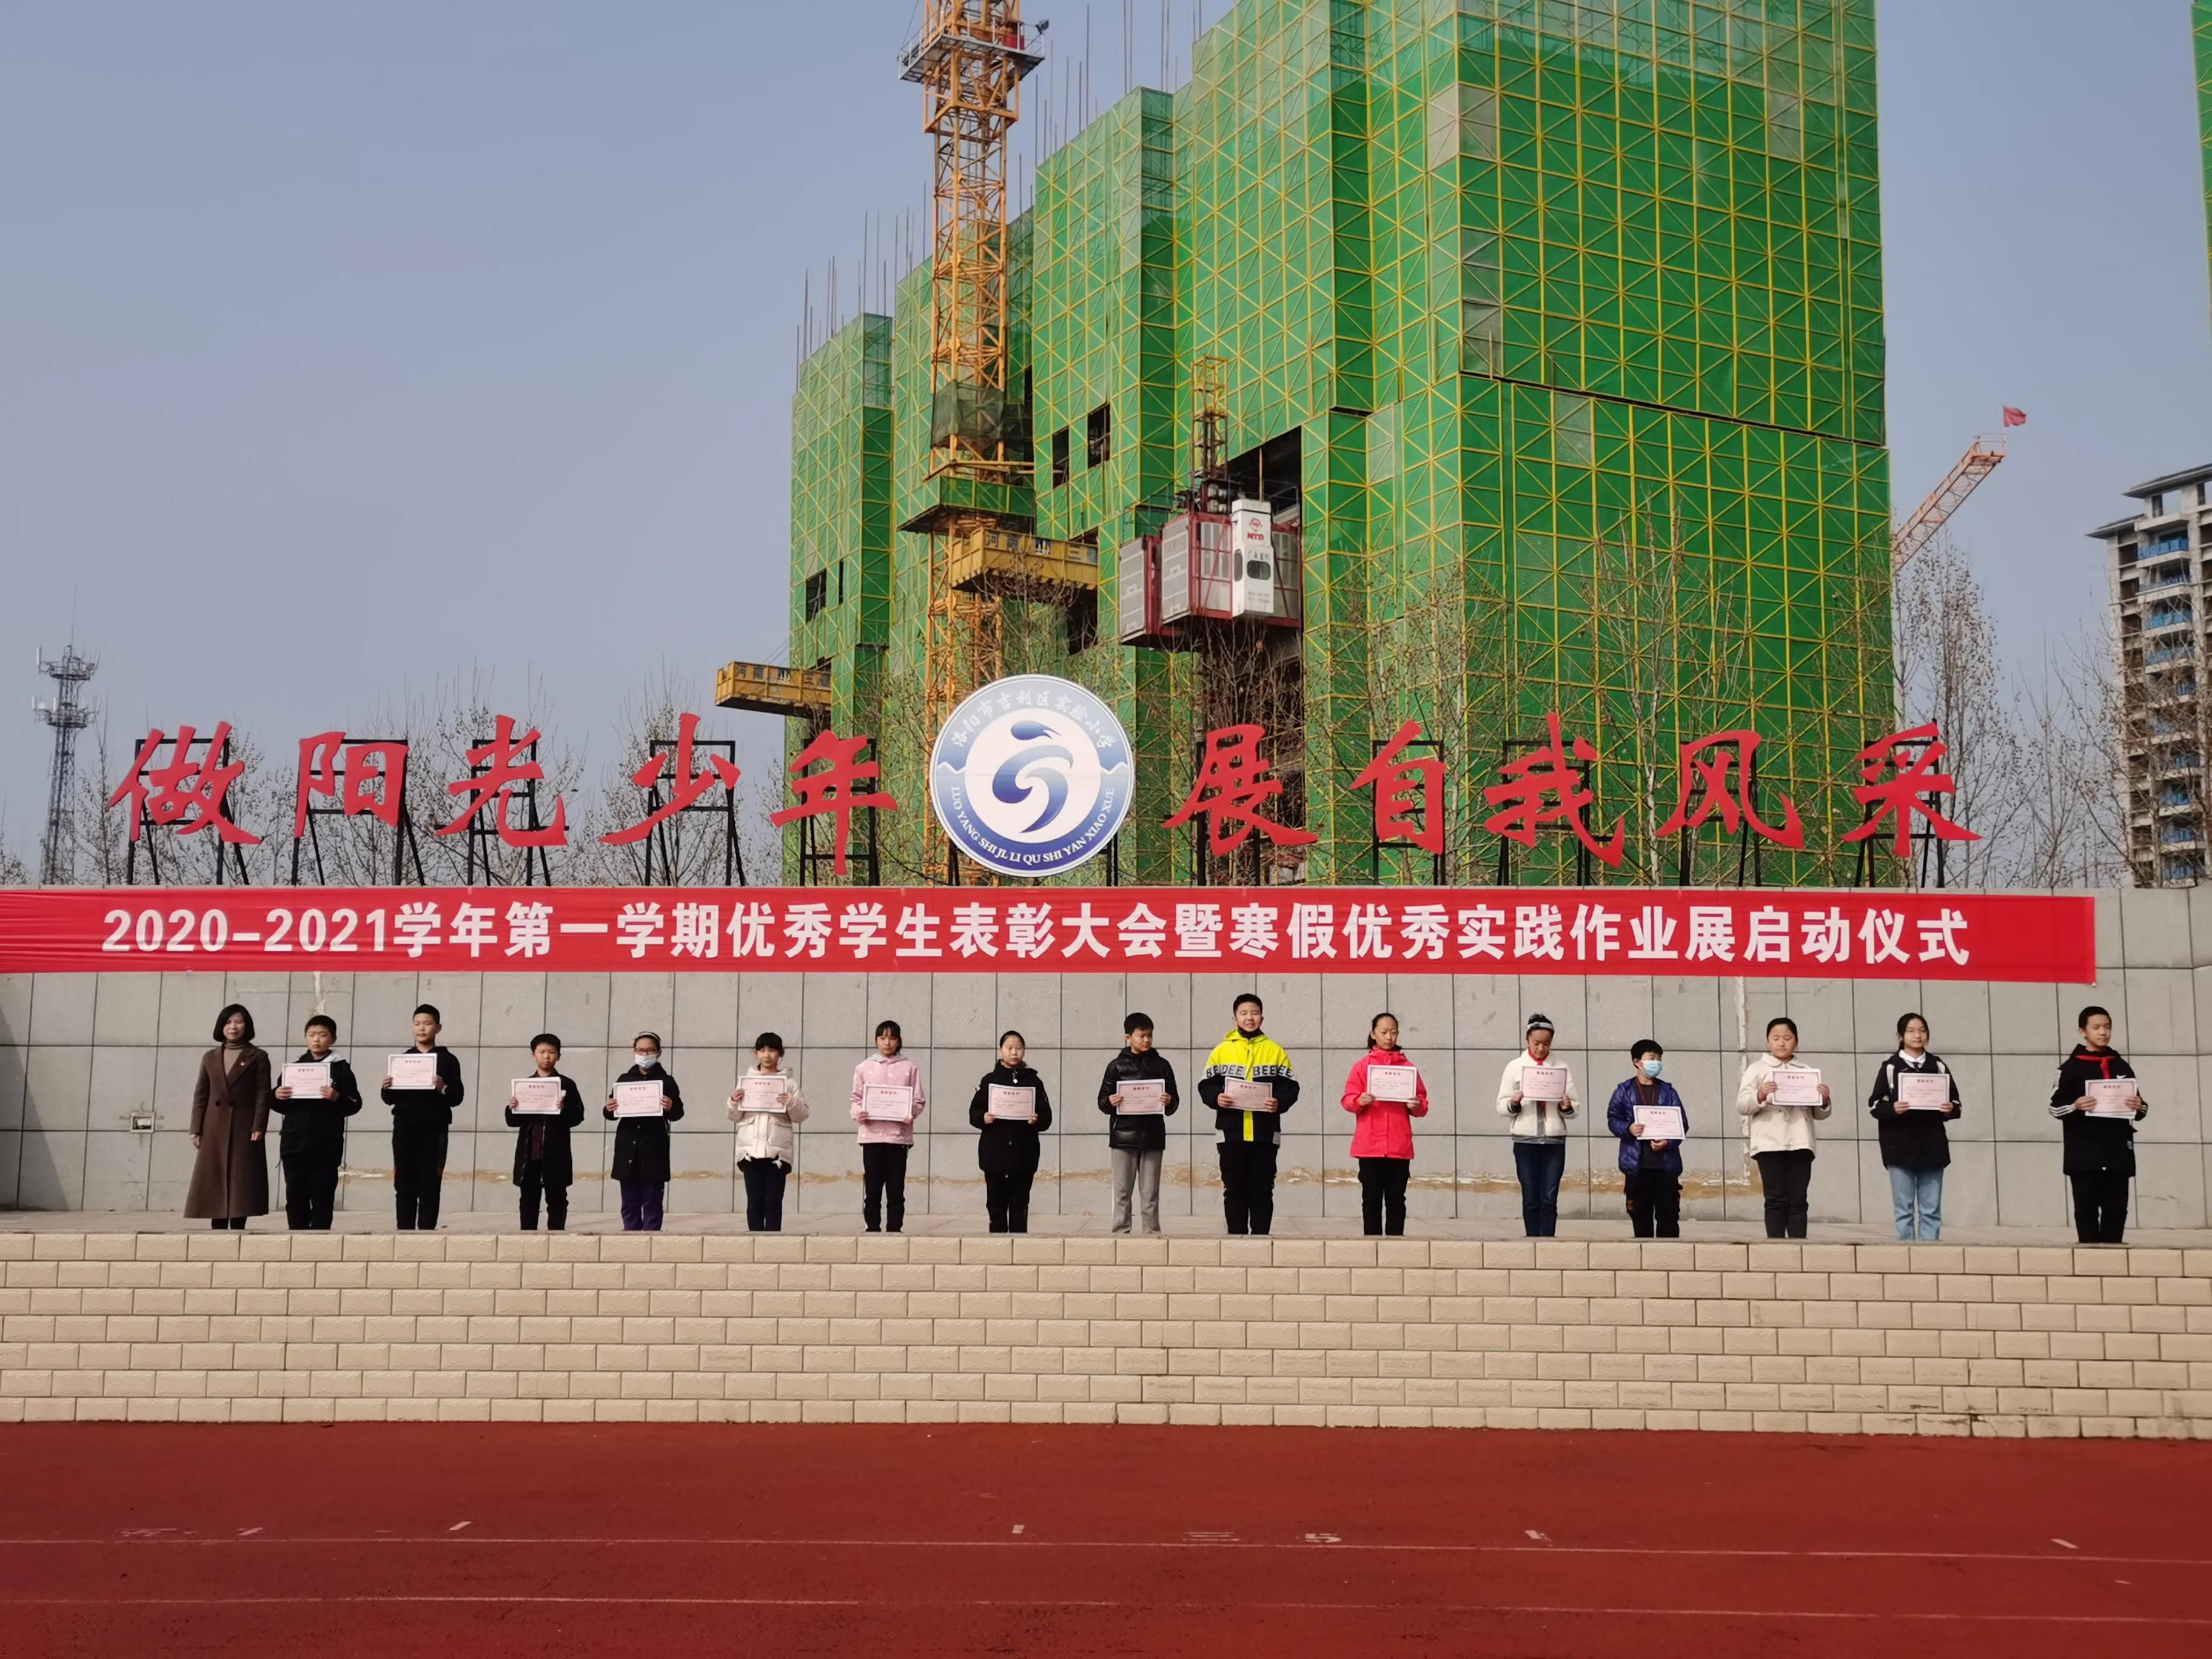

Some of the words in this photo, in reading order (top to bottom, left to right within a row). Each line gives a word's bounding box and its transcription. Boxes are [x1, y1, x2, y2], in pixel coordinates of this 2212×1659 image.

[109, 712, 897, 876] 做阳光少年
[951, 786, 963, 810] LUO
[957, 810, 980, 841] YANG
[978, 837, 998, 855] SHI
[1009, 851, 1021, 862] LI
[1022, 853, 1041, 866] QU
[1042, 849, 1063, 862] SHI
[1062, 836, 1087, 856] YAN
[1084, 813, 1107, 842] XIAO
[1101, 787, 1115, 813] XUE
[1162, 712, 1982, 868] 展自我风采
